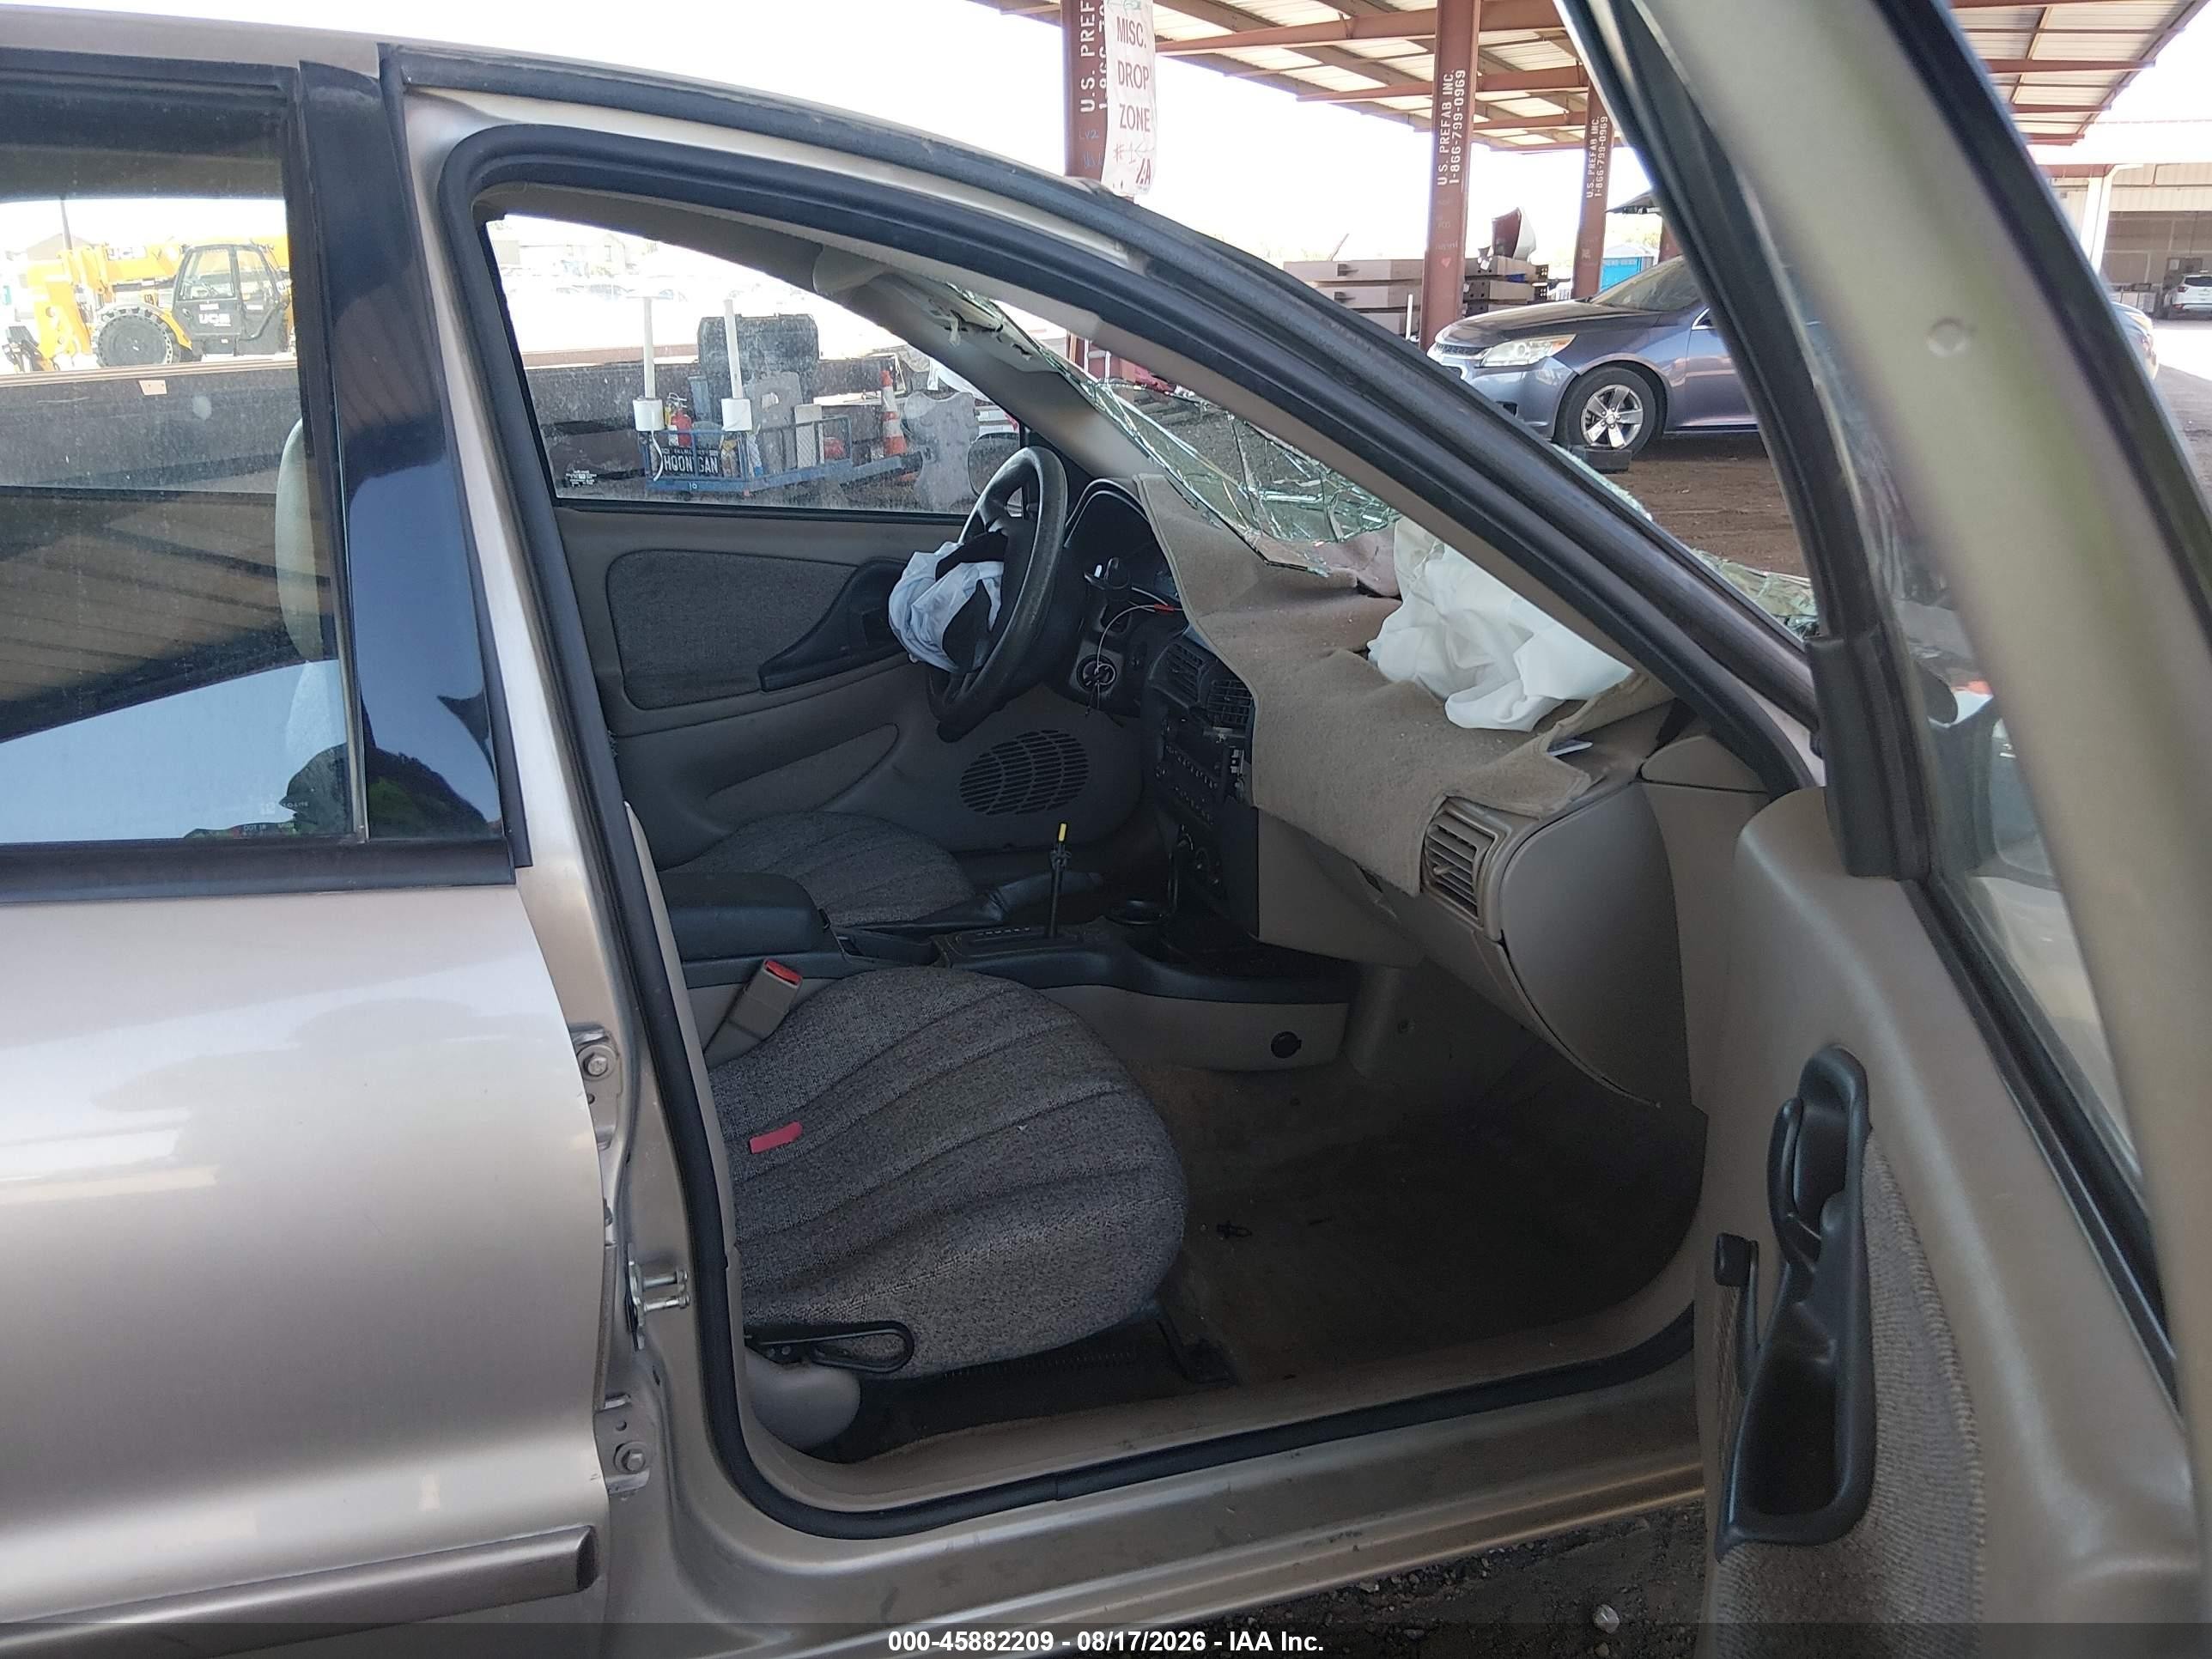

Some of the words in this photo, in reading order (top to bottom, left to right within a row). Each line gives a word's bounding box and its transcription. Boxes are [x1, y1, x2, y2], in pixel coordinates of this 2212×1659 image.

[1116, 15, 1147, 49] MISC.
[1117, 59, 1150, 89] DROP
[1443, 68, 1455, 95] INC.
[1079, 70, 1096, 113] U.S.
[1119, 102, 1151, 133] ZONE
[1439, 101, 1453, 154] PREFAB
[1449, 69, 1466, 184] 1-866-799-0969
[1437, 160, 1449, 186] U.S.
[1587, 138, 1598, 176] PREFAB
[664, 454, 719, 474] HOONGAN
